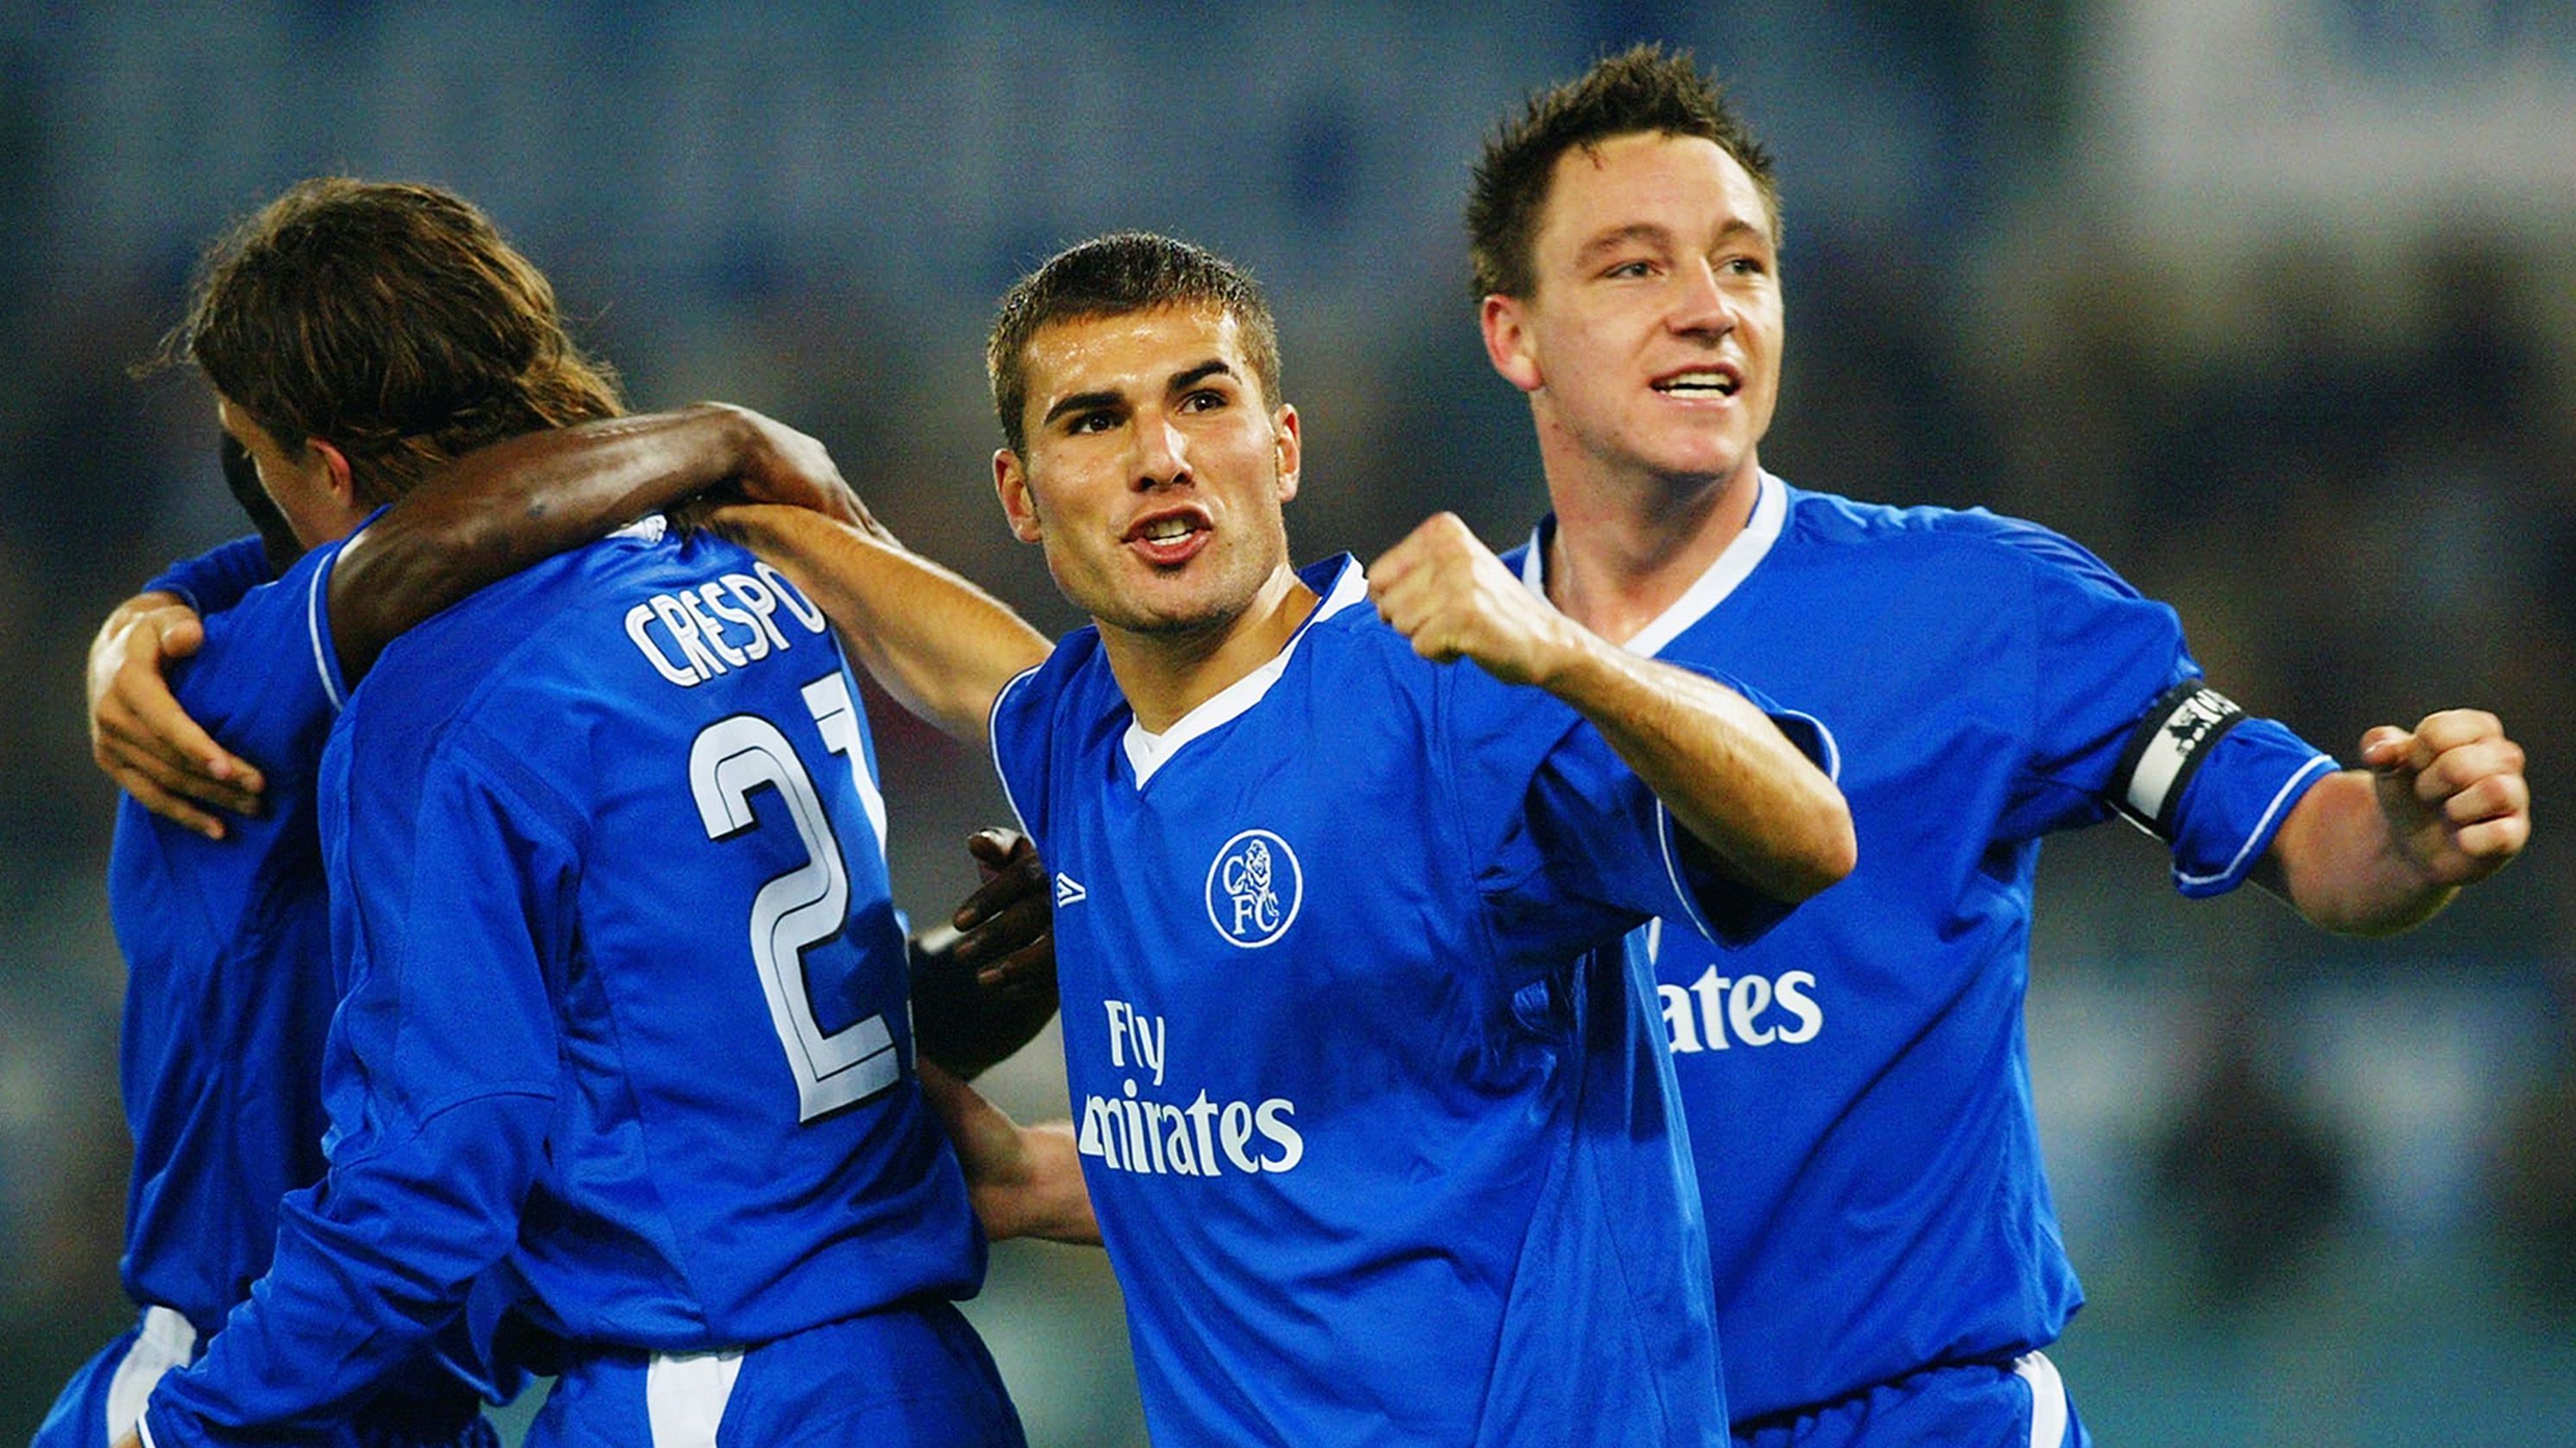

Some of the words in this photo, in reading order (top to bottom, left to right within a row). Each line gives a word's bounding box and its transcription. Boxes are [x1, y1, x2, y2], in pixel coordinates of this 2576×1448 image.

[625, 562, 826, 687] CRESPO
[1103, 999, 1165, 1086] Fly
[1656, 963, 1824, 1054] ates
